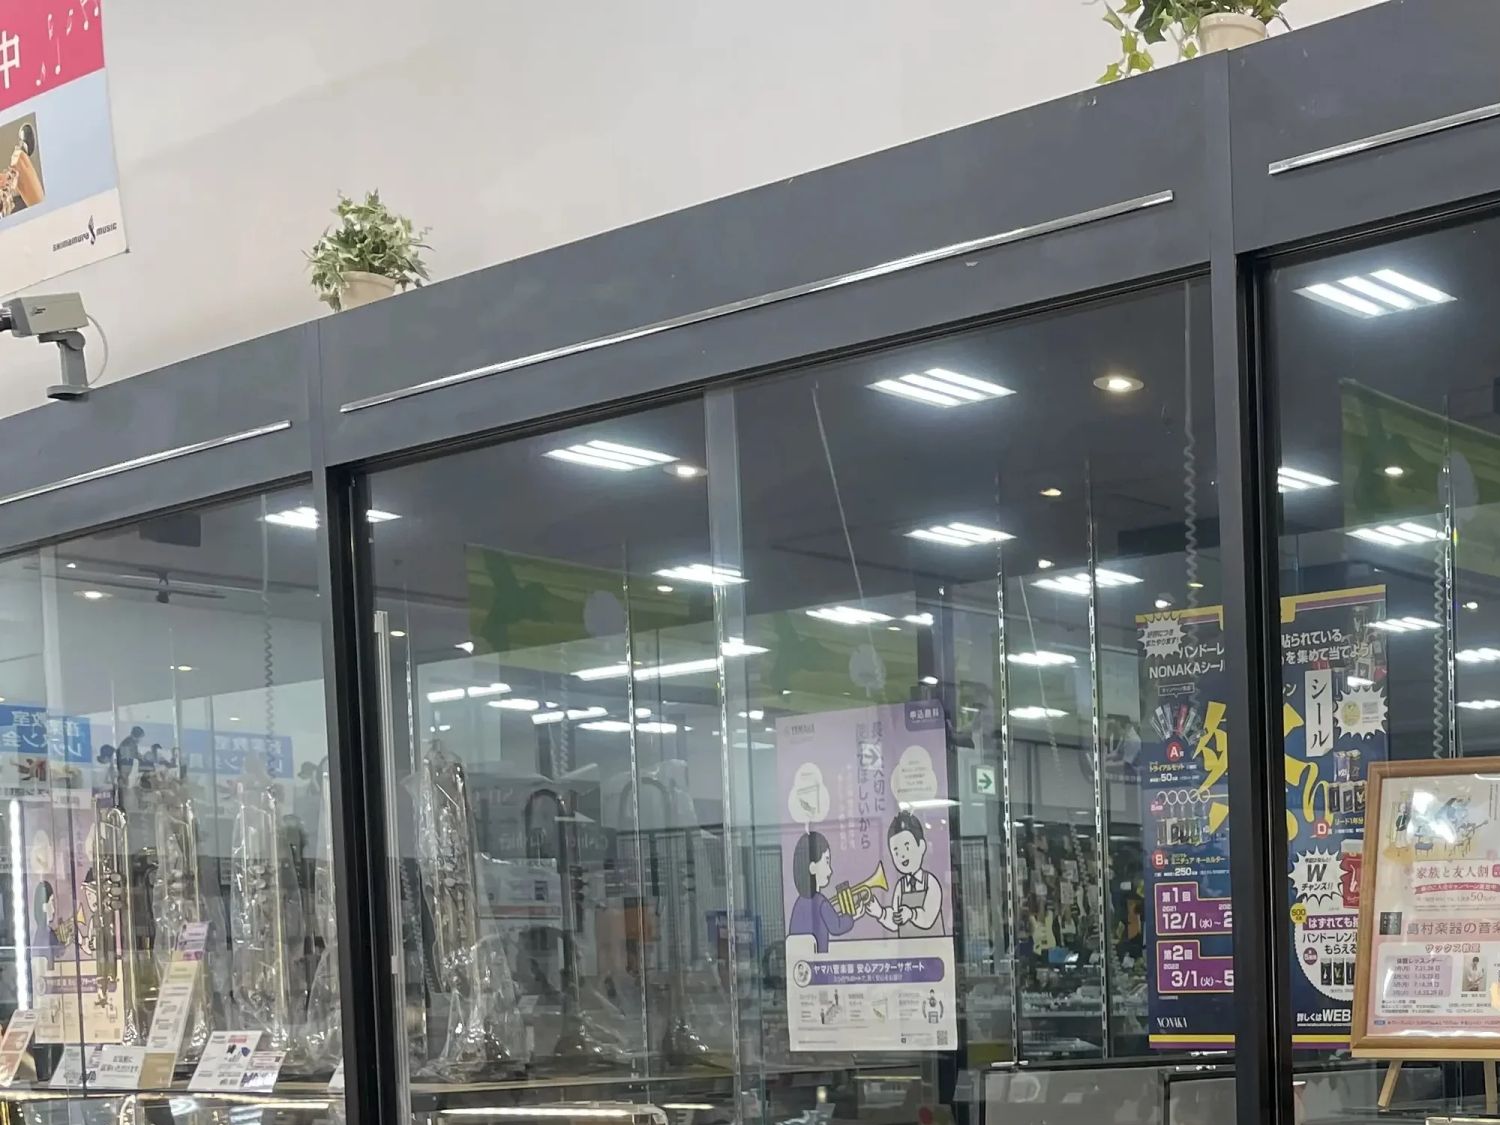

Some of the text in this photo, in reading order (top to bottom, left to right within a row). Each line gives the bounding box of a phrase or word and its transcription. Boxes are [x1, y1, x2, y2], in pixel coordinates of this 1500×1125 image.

[0, 30, 20, 89] 中
[1311, 677, 1330, 750] シール
[1307, 864, 1328, 883] W
[1415, 863, 1489, 880] 家族と友人割
[1162, 887, 1191, 903] 第1回
[1163, 944, 1193, 961] 第2回
